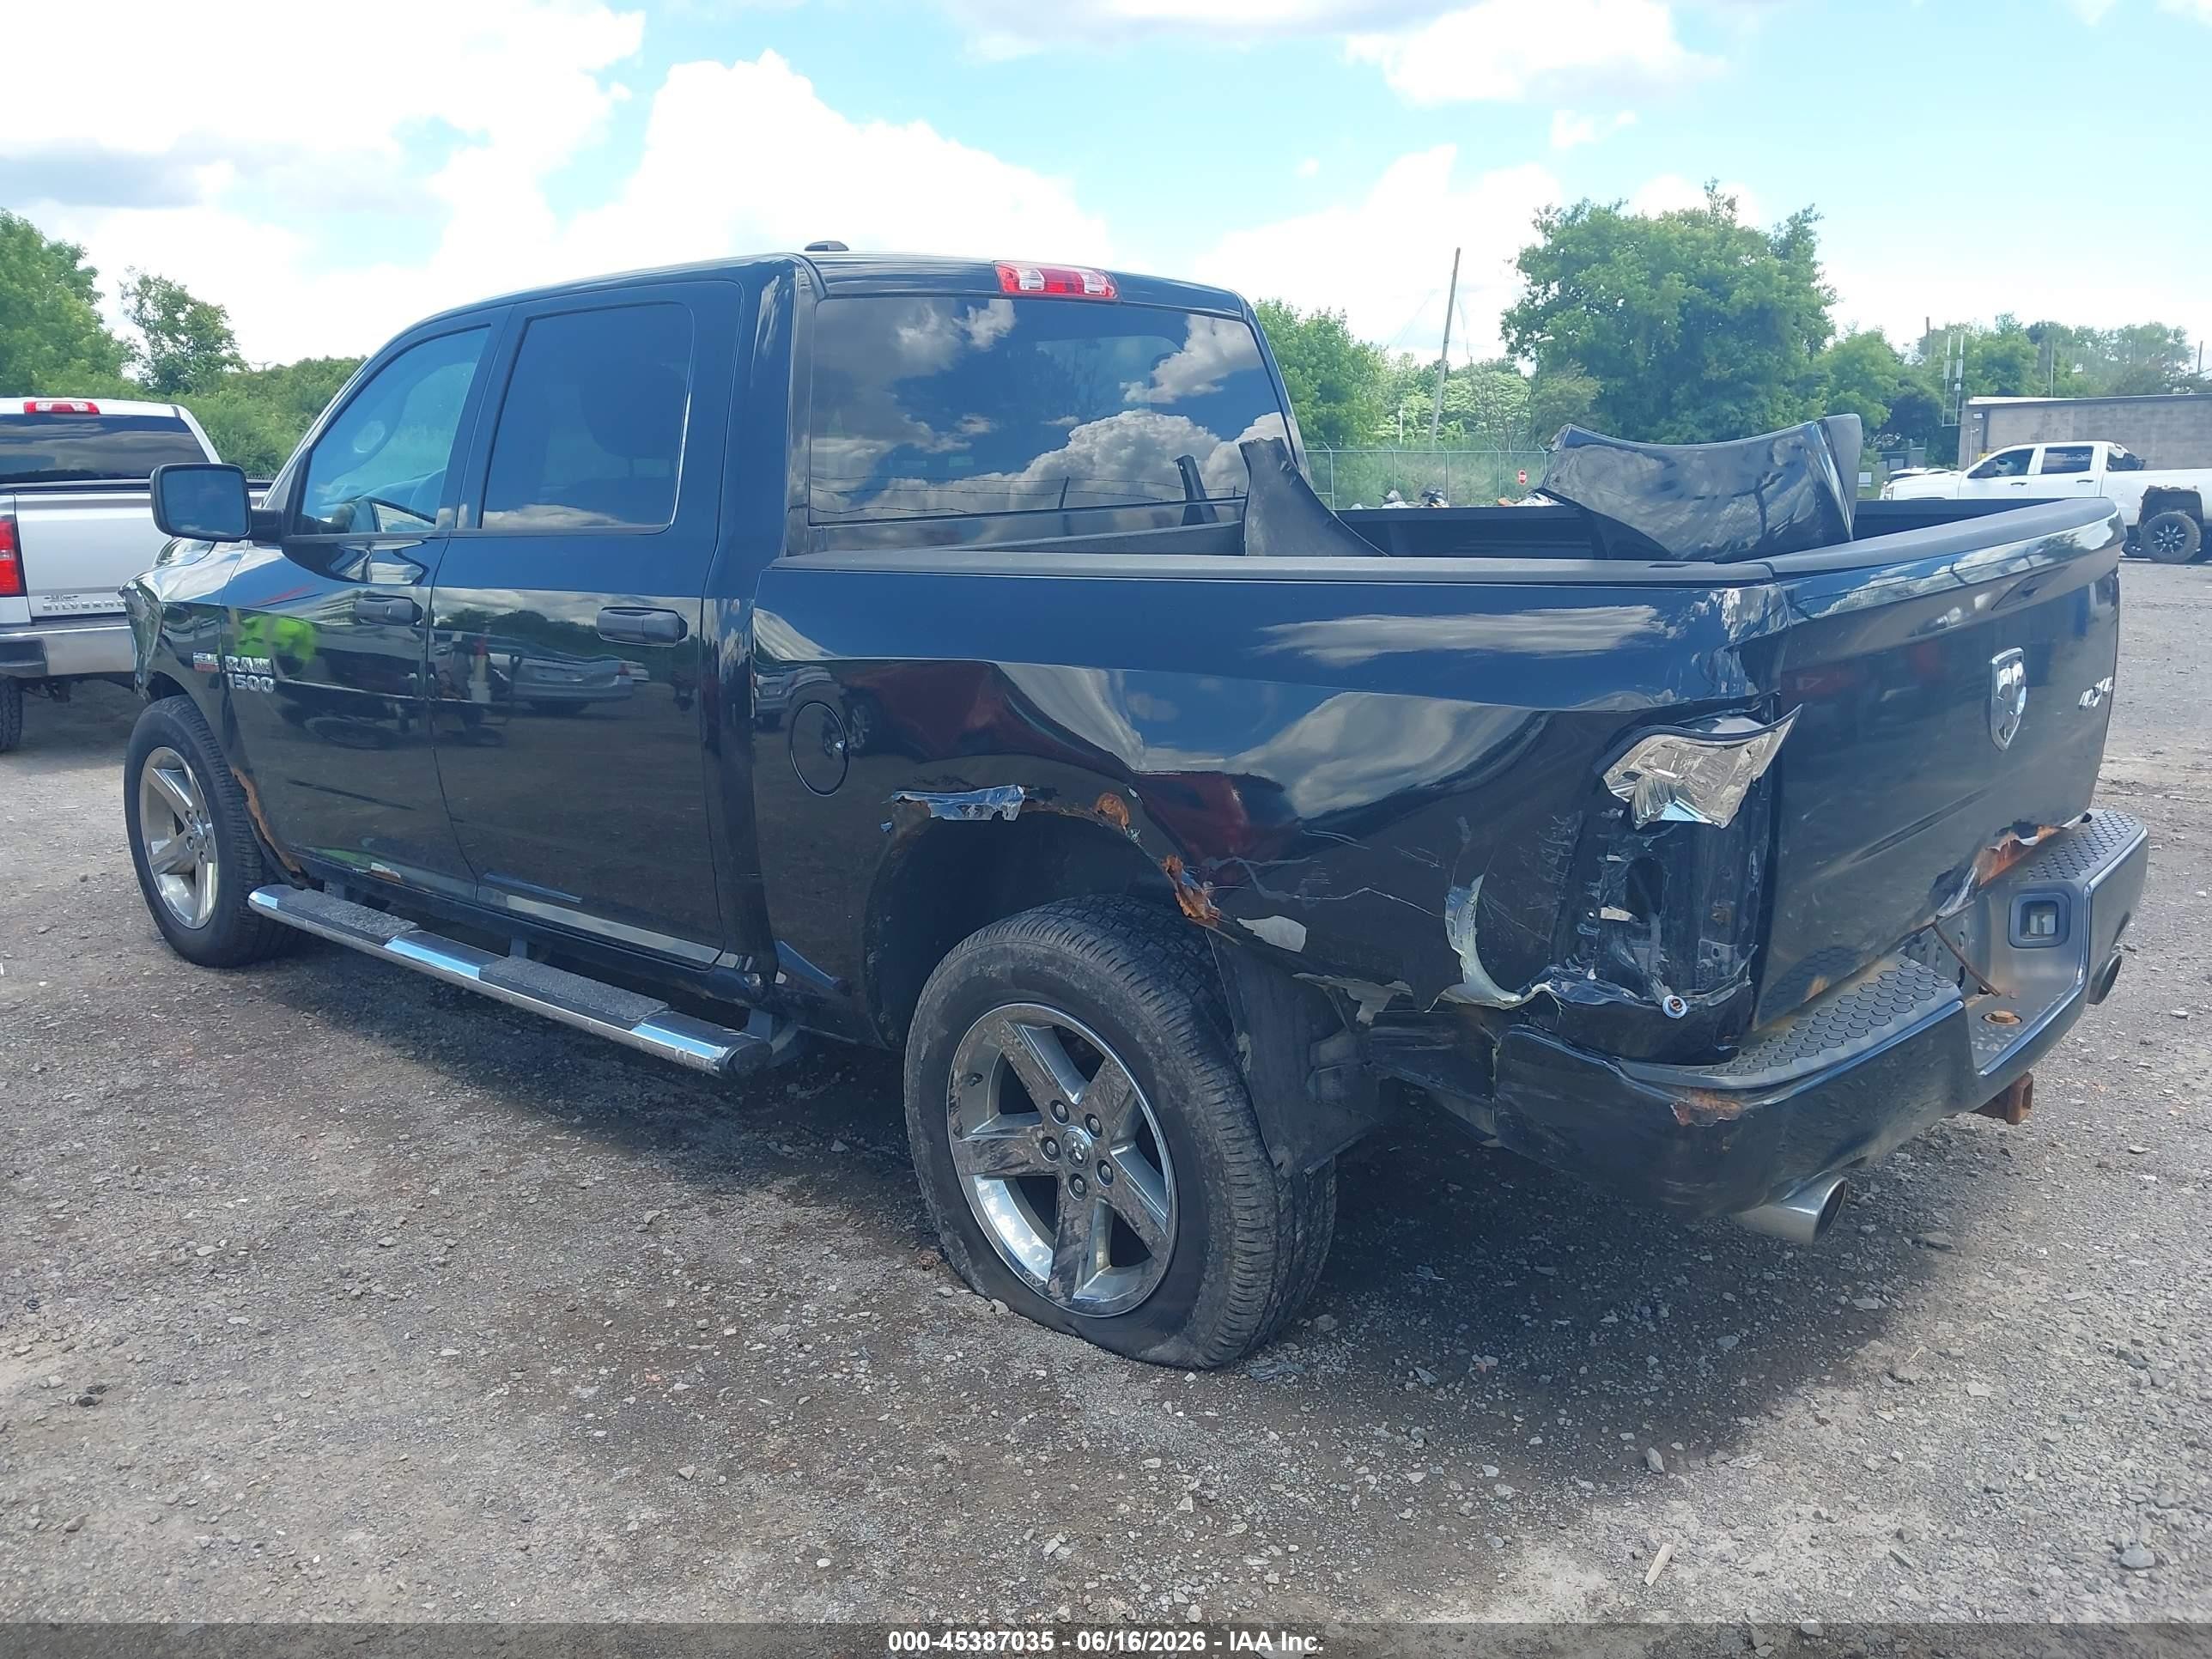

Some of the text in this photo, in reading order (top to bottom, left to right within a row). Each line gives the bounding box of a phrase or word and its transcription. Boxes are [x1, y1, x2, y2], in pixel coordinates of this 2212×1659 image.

[43, 600, 126, 611] SILVERAD
[225, 656, 273, 675] RAM
[227, 673, 275, 694] 1500
